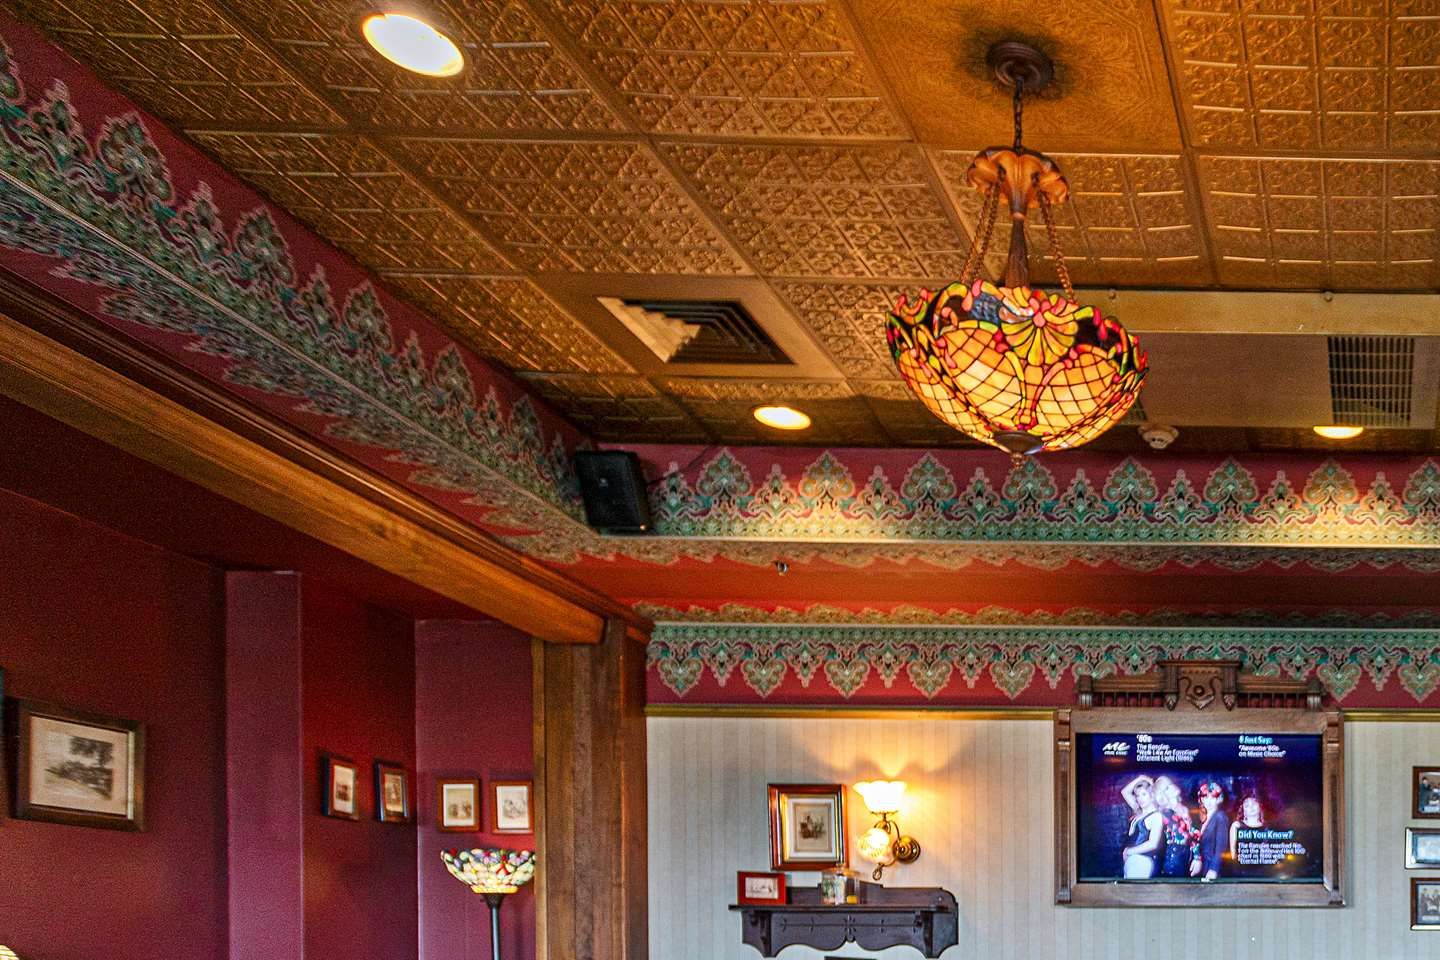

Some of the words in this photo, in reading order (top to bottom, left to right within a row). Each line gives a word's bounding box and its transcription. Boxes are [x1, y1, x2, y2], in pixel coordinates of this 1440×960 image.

[1238, 830, 1252, 839] Did
[1252, 830, 1266, 839] You
[1267, 830, 1294, 839] Know?
